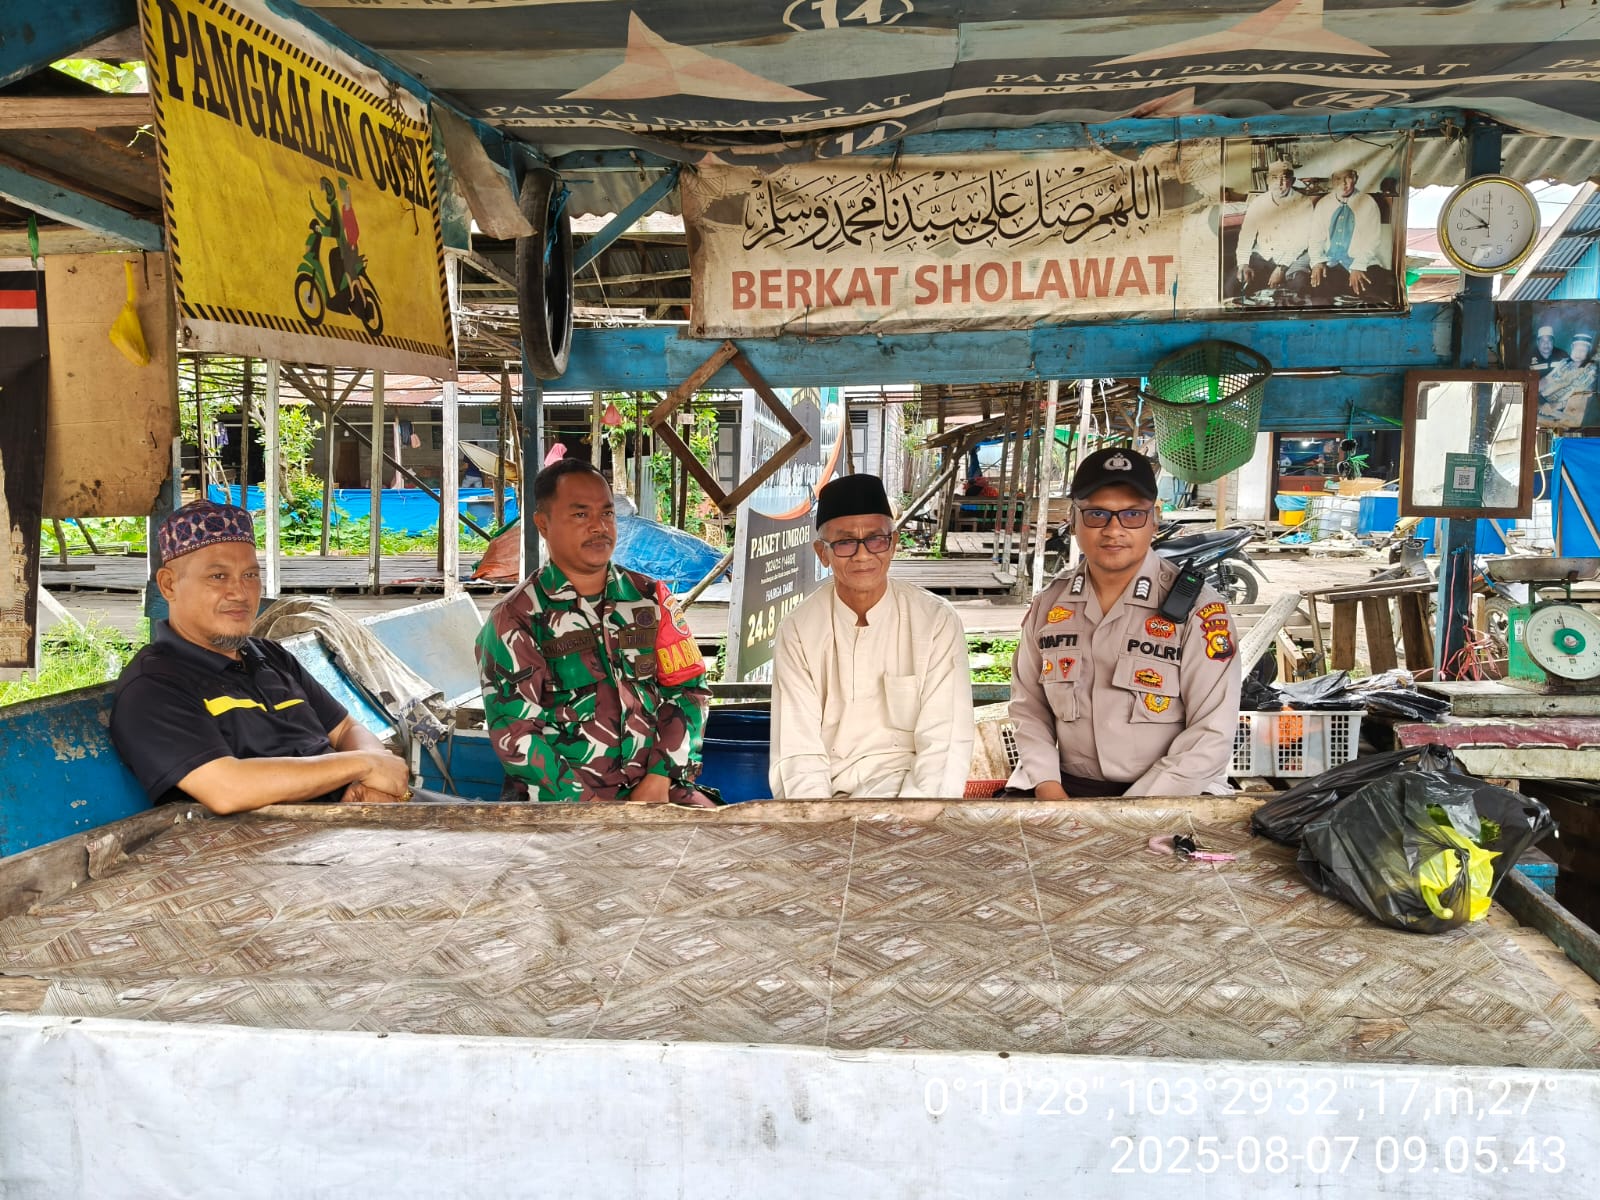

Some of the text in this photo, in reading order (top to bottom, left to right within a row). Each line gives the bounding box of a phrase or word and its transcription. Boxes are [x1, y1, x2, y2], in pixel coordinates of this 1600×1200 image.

[992, 62, 1470, 83] PARTAI DEMOKRAT
[1043, 77, 1188, 93] NASIR
[159, 0, 431, 209] PANGKALAN OJEK
[482, 94, 911, 128] PARTAI DEMOKRAT
[1317, 92, 1392, 108] 14
[835, 126, 886, 155] 14
[731, 255, 1174, 310] BERKAT SHOLAWAT
[749, 525, 811, 560] PAKET UMROH
[747, 605, 776, 648] 24.8
[1127, 639, 1182, 661] POLRI
